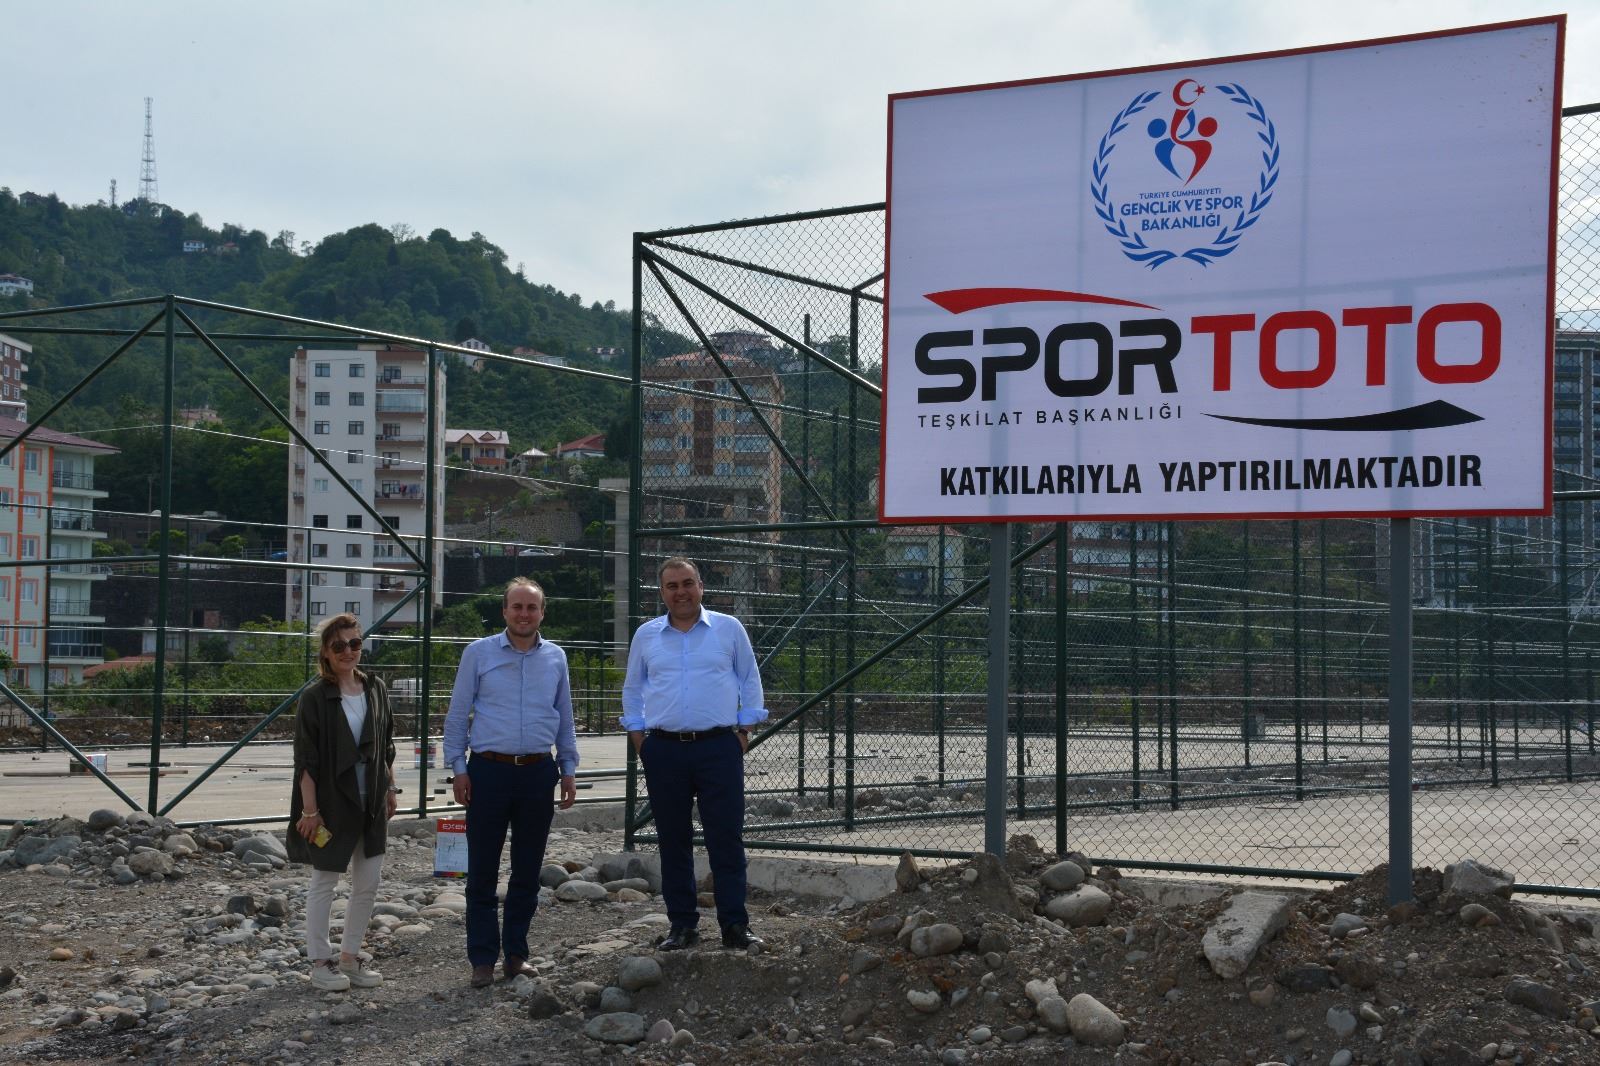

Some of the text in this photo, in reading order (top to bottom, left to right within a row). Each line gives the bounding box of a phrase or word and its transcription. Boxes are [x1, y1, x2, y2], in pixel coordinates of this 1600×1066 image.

[1184, 199, 1203, 211] VE
[1205, 196, 1244, 211] SPOR
[1141, 212, 1221, 231] BAKANLIĞI
[917, 402, 1182, 431] TEŞKİLAT BAŞKANLIĞI
[940, 454, 1483, 496] KATKILARIYLA YAPTIRILMAKTADIR
